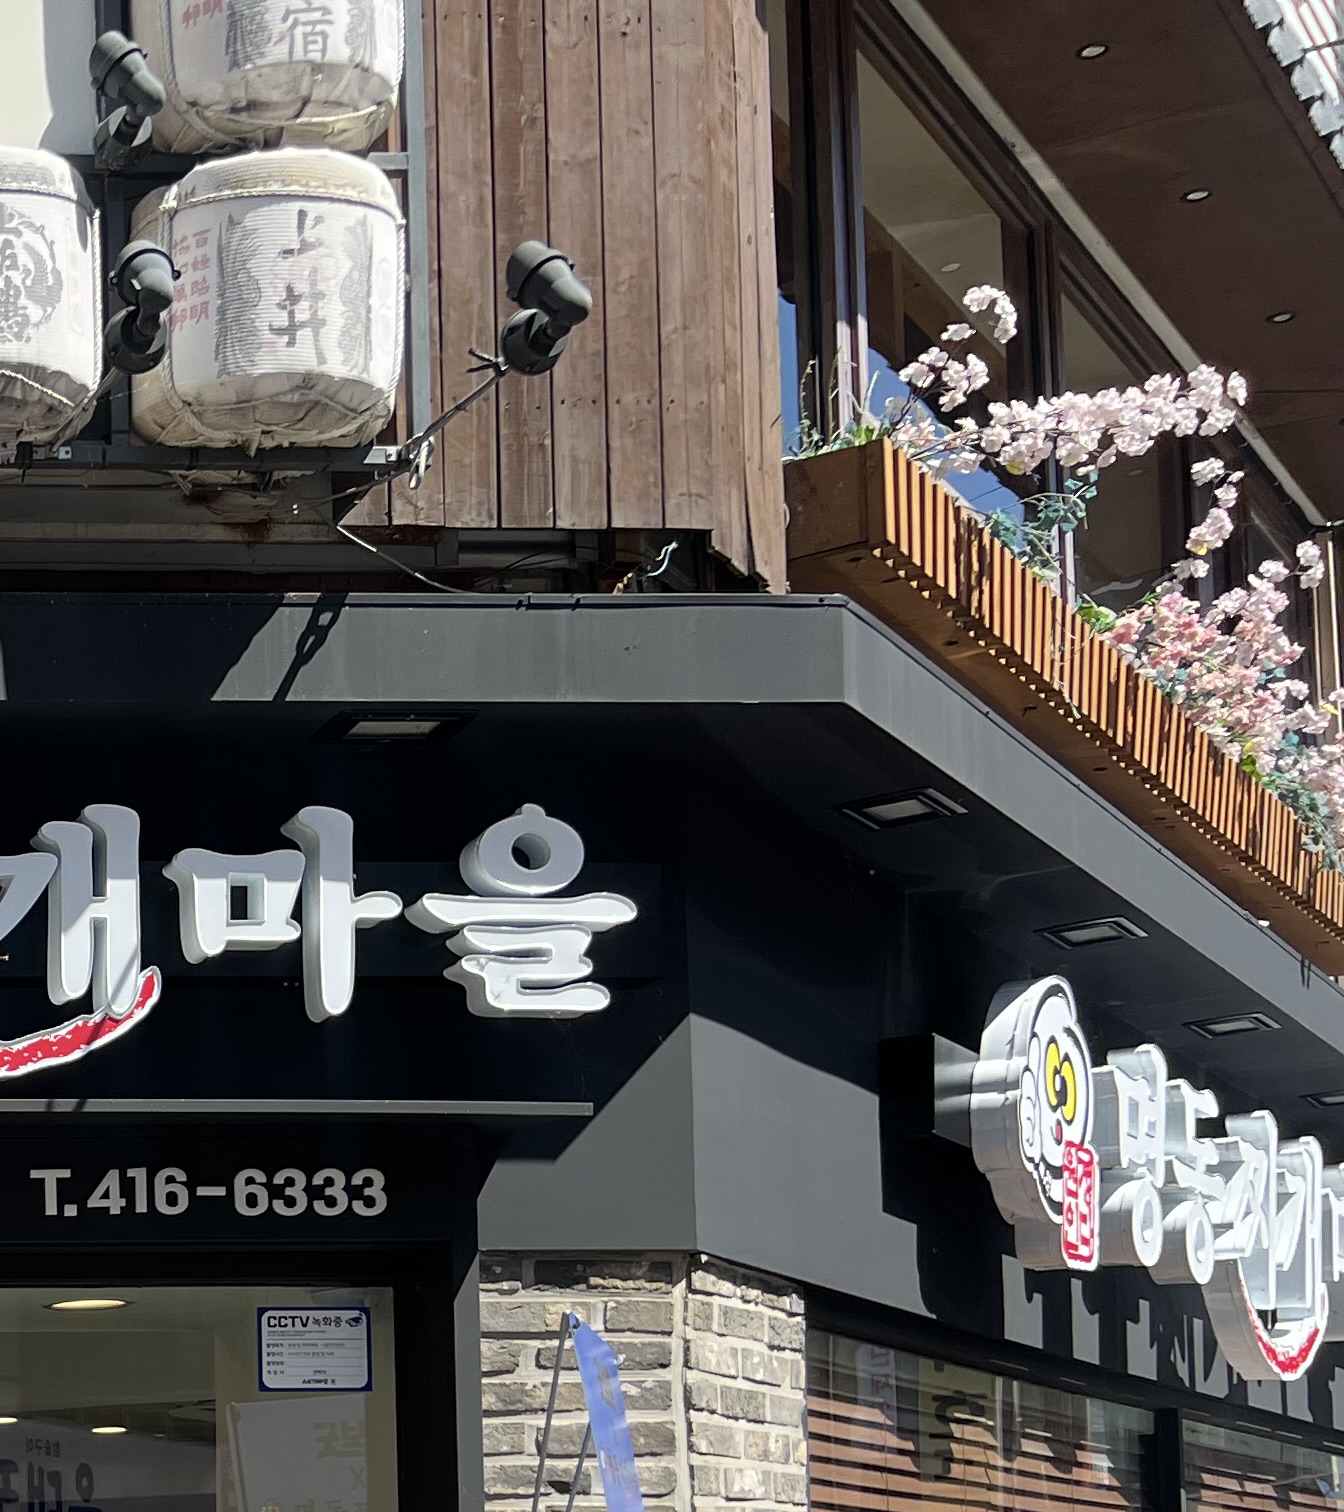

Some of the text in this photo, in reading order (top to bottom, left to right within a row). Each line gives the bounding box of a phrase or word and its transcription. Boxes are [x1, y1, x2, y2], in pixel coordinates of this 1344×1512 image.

[30, 1167, 389, 1218] T.416-6333
[266, 1315, 344, 1329] CCTV 녹화중
